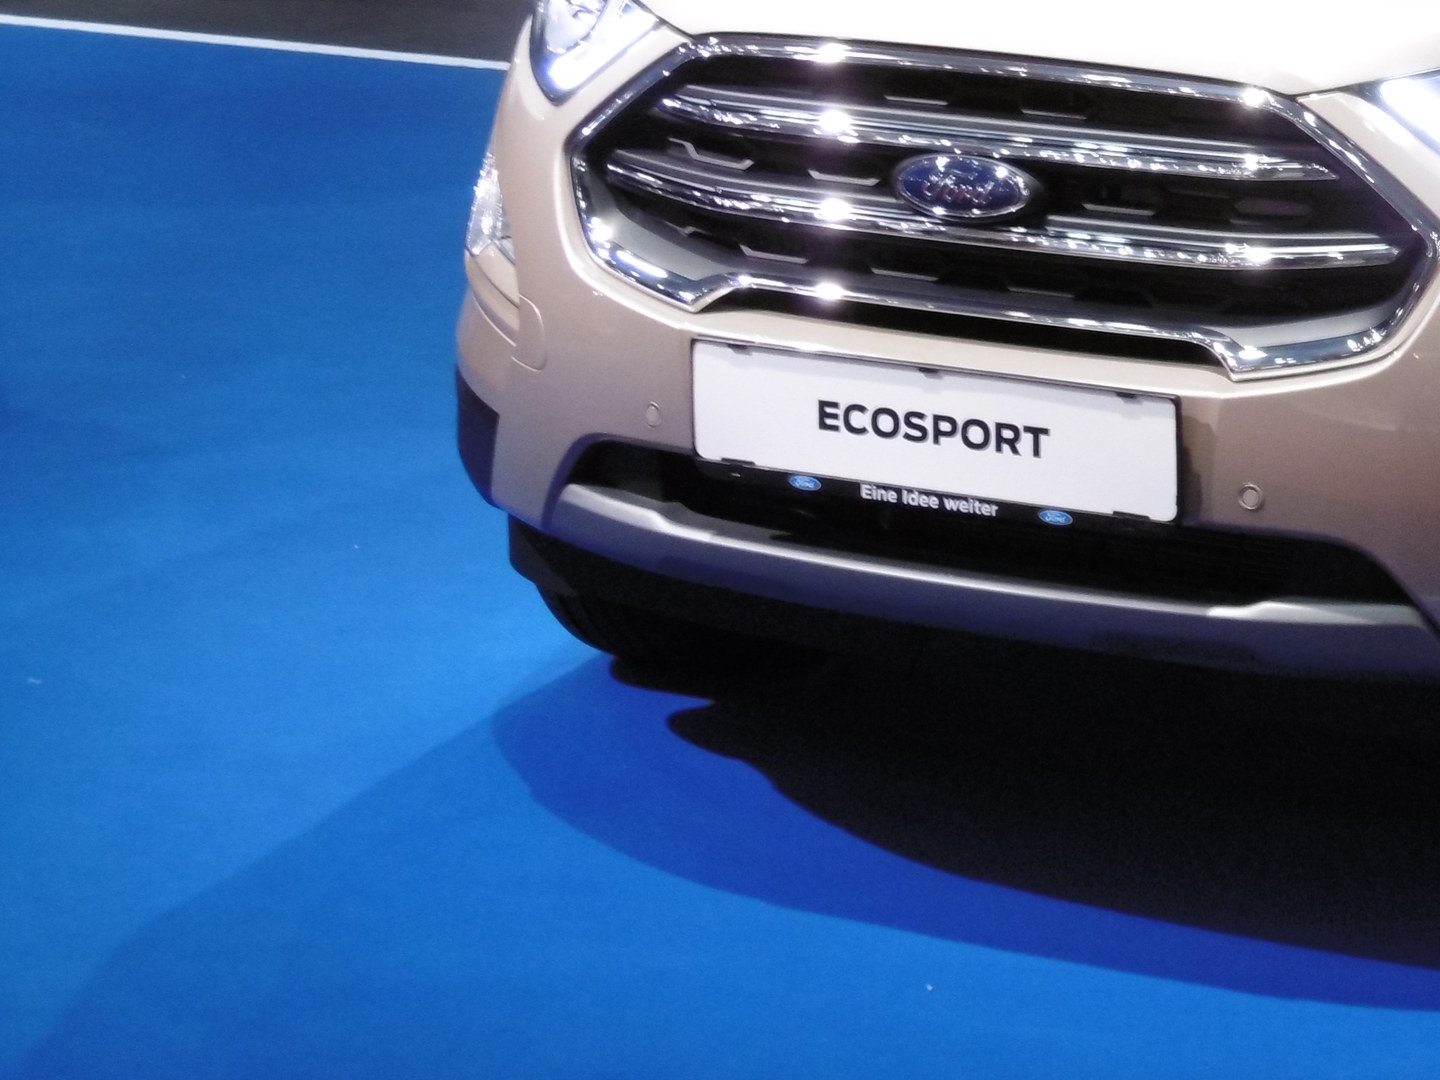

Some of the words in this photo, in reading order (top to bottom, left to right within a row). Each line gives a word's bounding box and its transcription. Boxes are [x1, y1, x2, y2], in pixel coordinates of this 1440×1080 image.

[816, 399, 1050, 460] ECOSPORT
[859, 483, 898, 503] Eine
[901, 488, 939, 509] Idee
[943, 496, 999, 517] weiter
